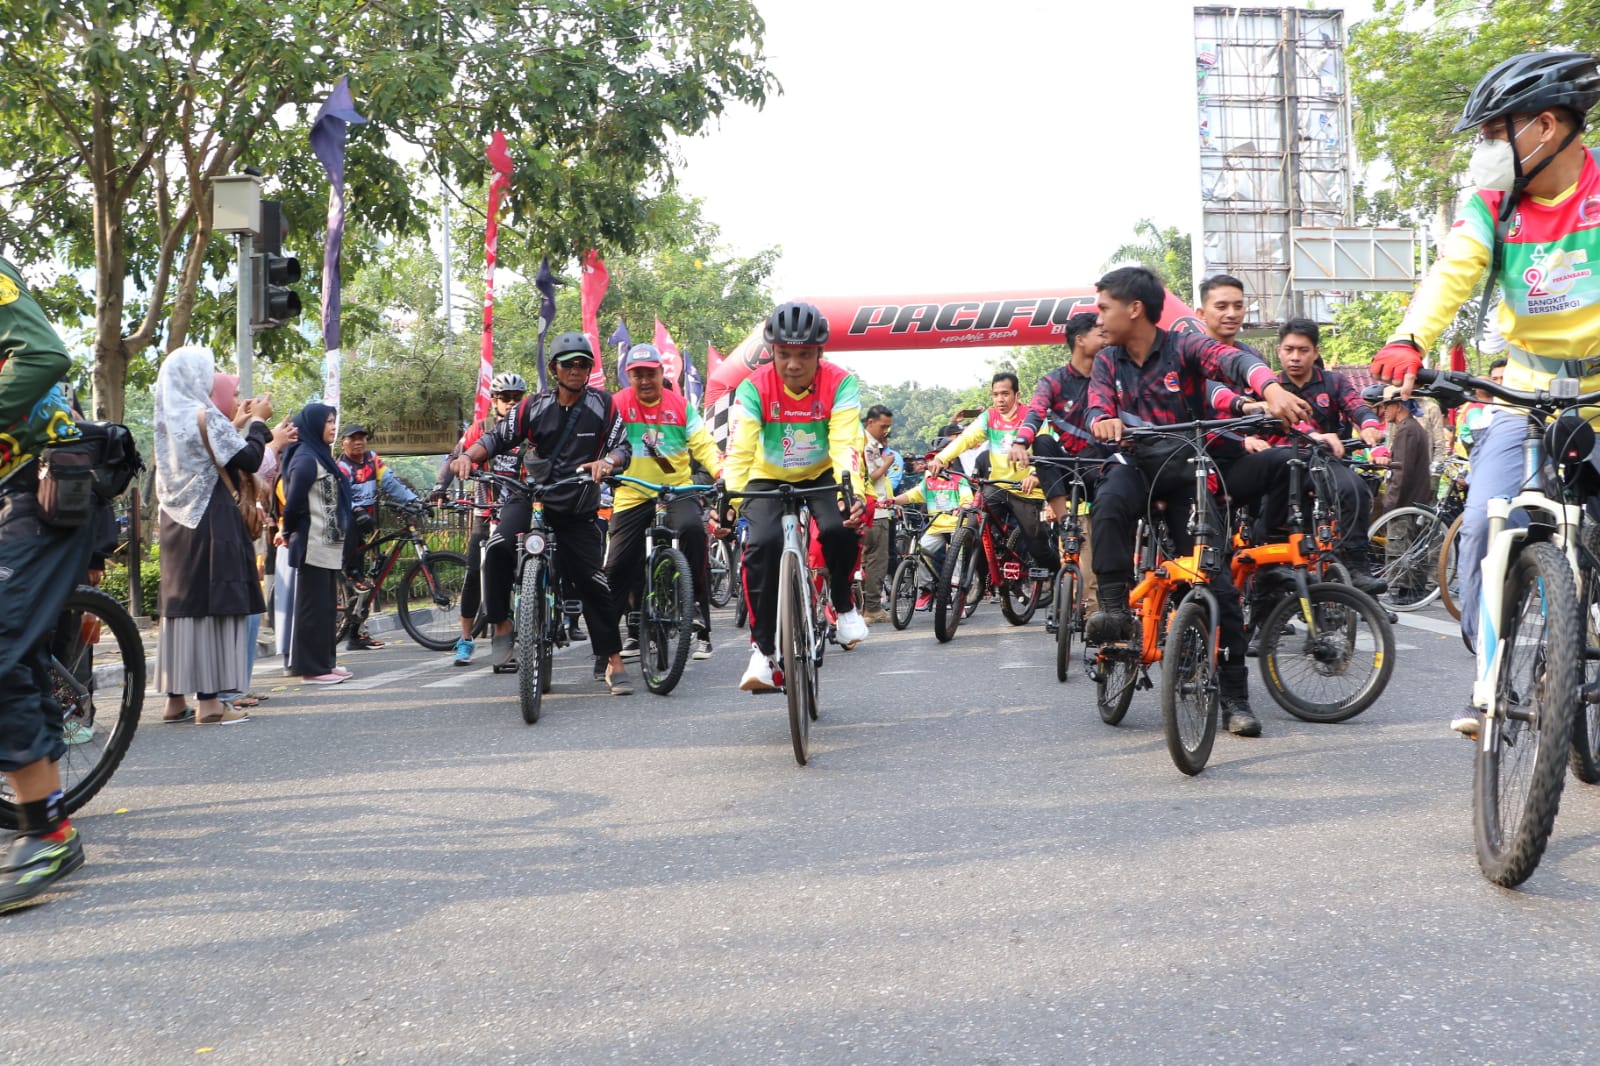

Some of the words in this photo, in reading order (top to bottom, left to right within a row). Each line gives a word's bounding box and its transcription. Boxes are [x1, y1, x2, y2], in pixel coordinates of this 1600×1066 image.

[1528, 295, 1567, 307] BANGKIT
[1528, 300, 1580, 314] BERSINERGI
[848, 297, 1097, 336] PACIFIC
[988, 329, 1019, 340] BEDA
